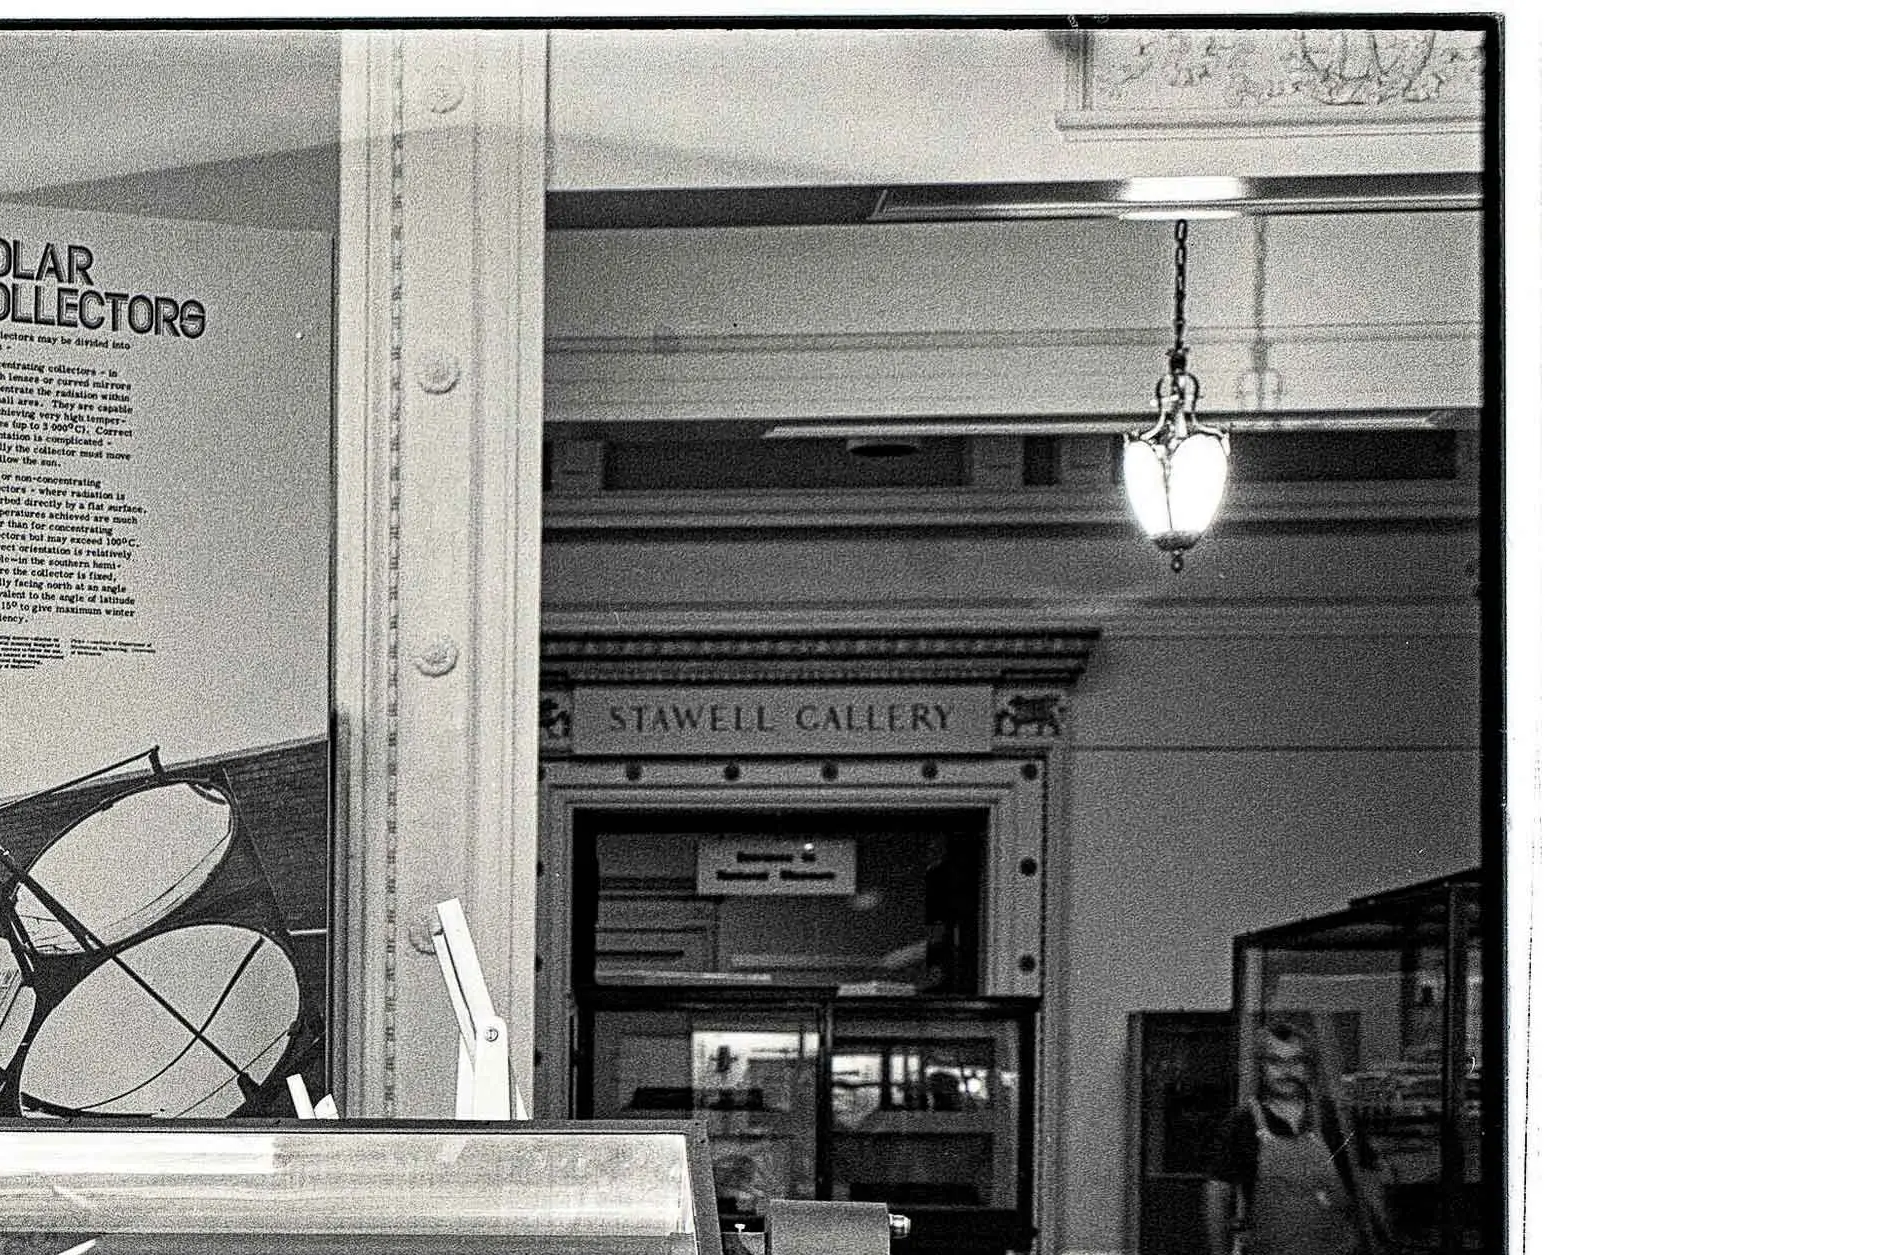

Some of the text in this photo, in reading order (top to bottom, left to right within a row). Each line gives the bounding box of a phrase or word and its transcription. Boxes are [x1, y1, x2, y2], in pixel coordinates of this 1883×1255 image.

[38, 335, 57, 345] may
[61, 336, 71, 345] be
[75, 337, 108, 348] divided
[113, 340, 130, 350] into
[48, 365, 96, 376] collectors
[109, 369, 117, 377] in
[9, 374, 39, 383] lenses
[57, 377, 89, 387] curved
[93, 381, 131, 390] mirrors
[37, 388, 52, 396] the
[55, 389, 98, 399] radiation
[52, 400, 74, 411] They
[98, 405, 133, 415] capable
[39, 414, 60, 422] very
[64, 413, 83, 424] high
[12, 420, 27, 431] (up
[95, 426, 133, 437] Correct
[33, 434, 42, 442] is
[46, 435, 103, 448] complicated
[16, 444, 30, 453] the
[33, 446, 76, 457] collector
[80, 449, 103, 459] must
[106, 453, 130, 461] move
[23, 456, 37, 465] the
[15, 474, 101, 489] non-concentrating
[39, 487, 67, 496] where
[71, 490, 113, 500] radiation
[24, 497, 62, 509] directly
[65, 501, 76, 511] by
[79, 502, 84, 510] a
[87, 502, 104, 511] flat
[49, 511, 89, 522] achieved
[94, 515, 109, 523] are
[113, 515, 137, 524] much
[8, 520, 28, 529] than
[31, 522, 46, 531] for
[49, 524, 113, 537] concentrating
[30, 534, 43, 542] but
[47, 536, 67, 545] may
[70, 536, 103, 546] exceed
[19, 544, 71, 555] orientation
[74, 548, 83, 556] is
[31, 557, 45, 565] the
[48, 558, 89, 568] southern
[13, 568, 28, 577] the
[31, 570, 74, 579] collector
[77, 572, 86, 580] is
[15, 580, 43, 590] facing
[47, 581, 72, 590] north
[102, 585, 126, 595] angle
[30, 592, 39, 600] to
[42, 593, 55, 601] the
[59, 595, 84, 604] angle
[87, 595, 97, 603] of
[100, 595, 135, 605] latitude
[21, 603, 30, 611] to
[32, 604, 52, 614] give
[56, 606, 102, 615] maximum
[105, 608, 135, 617] winter
[609, 704, 953, 733] STAWELL GALLERY
